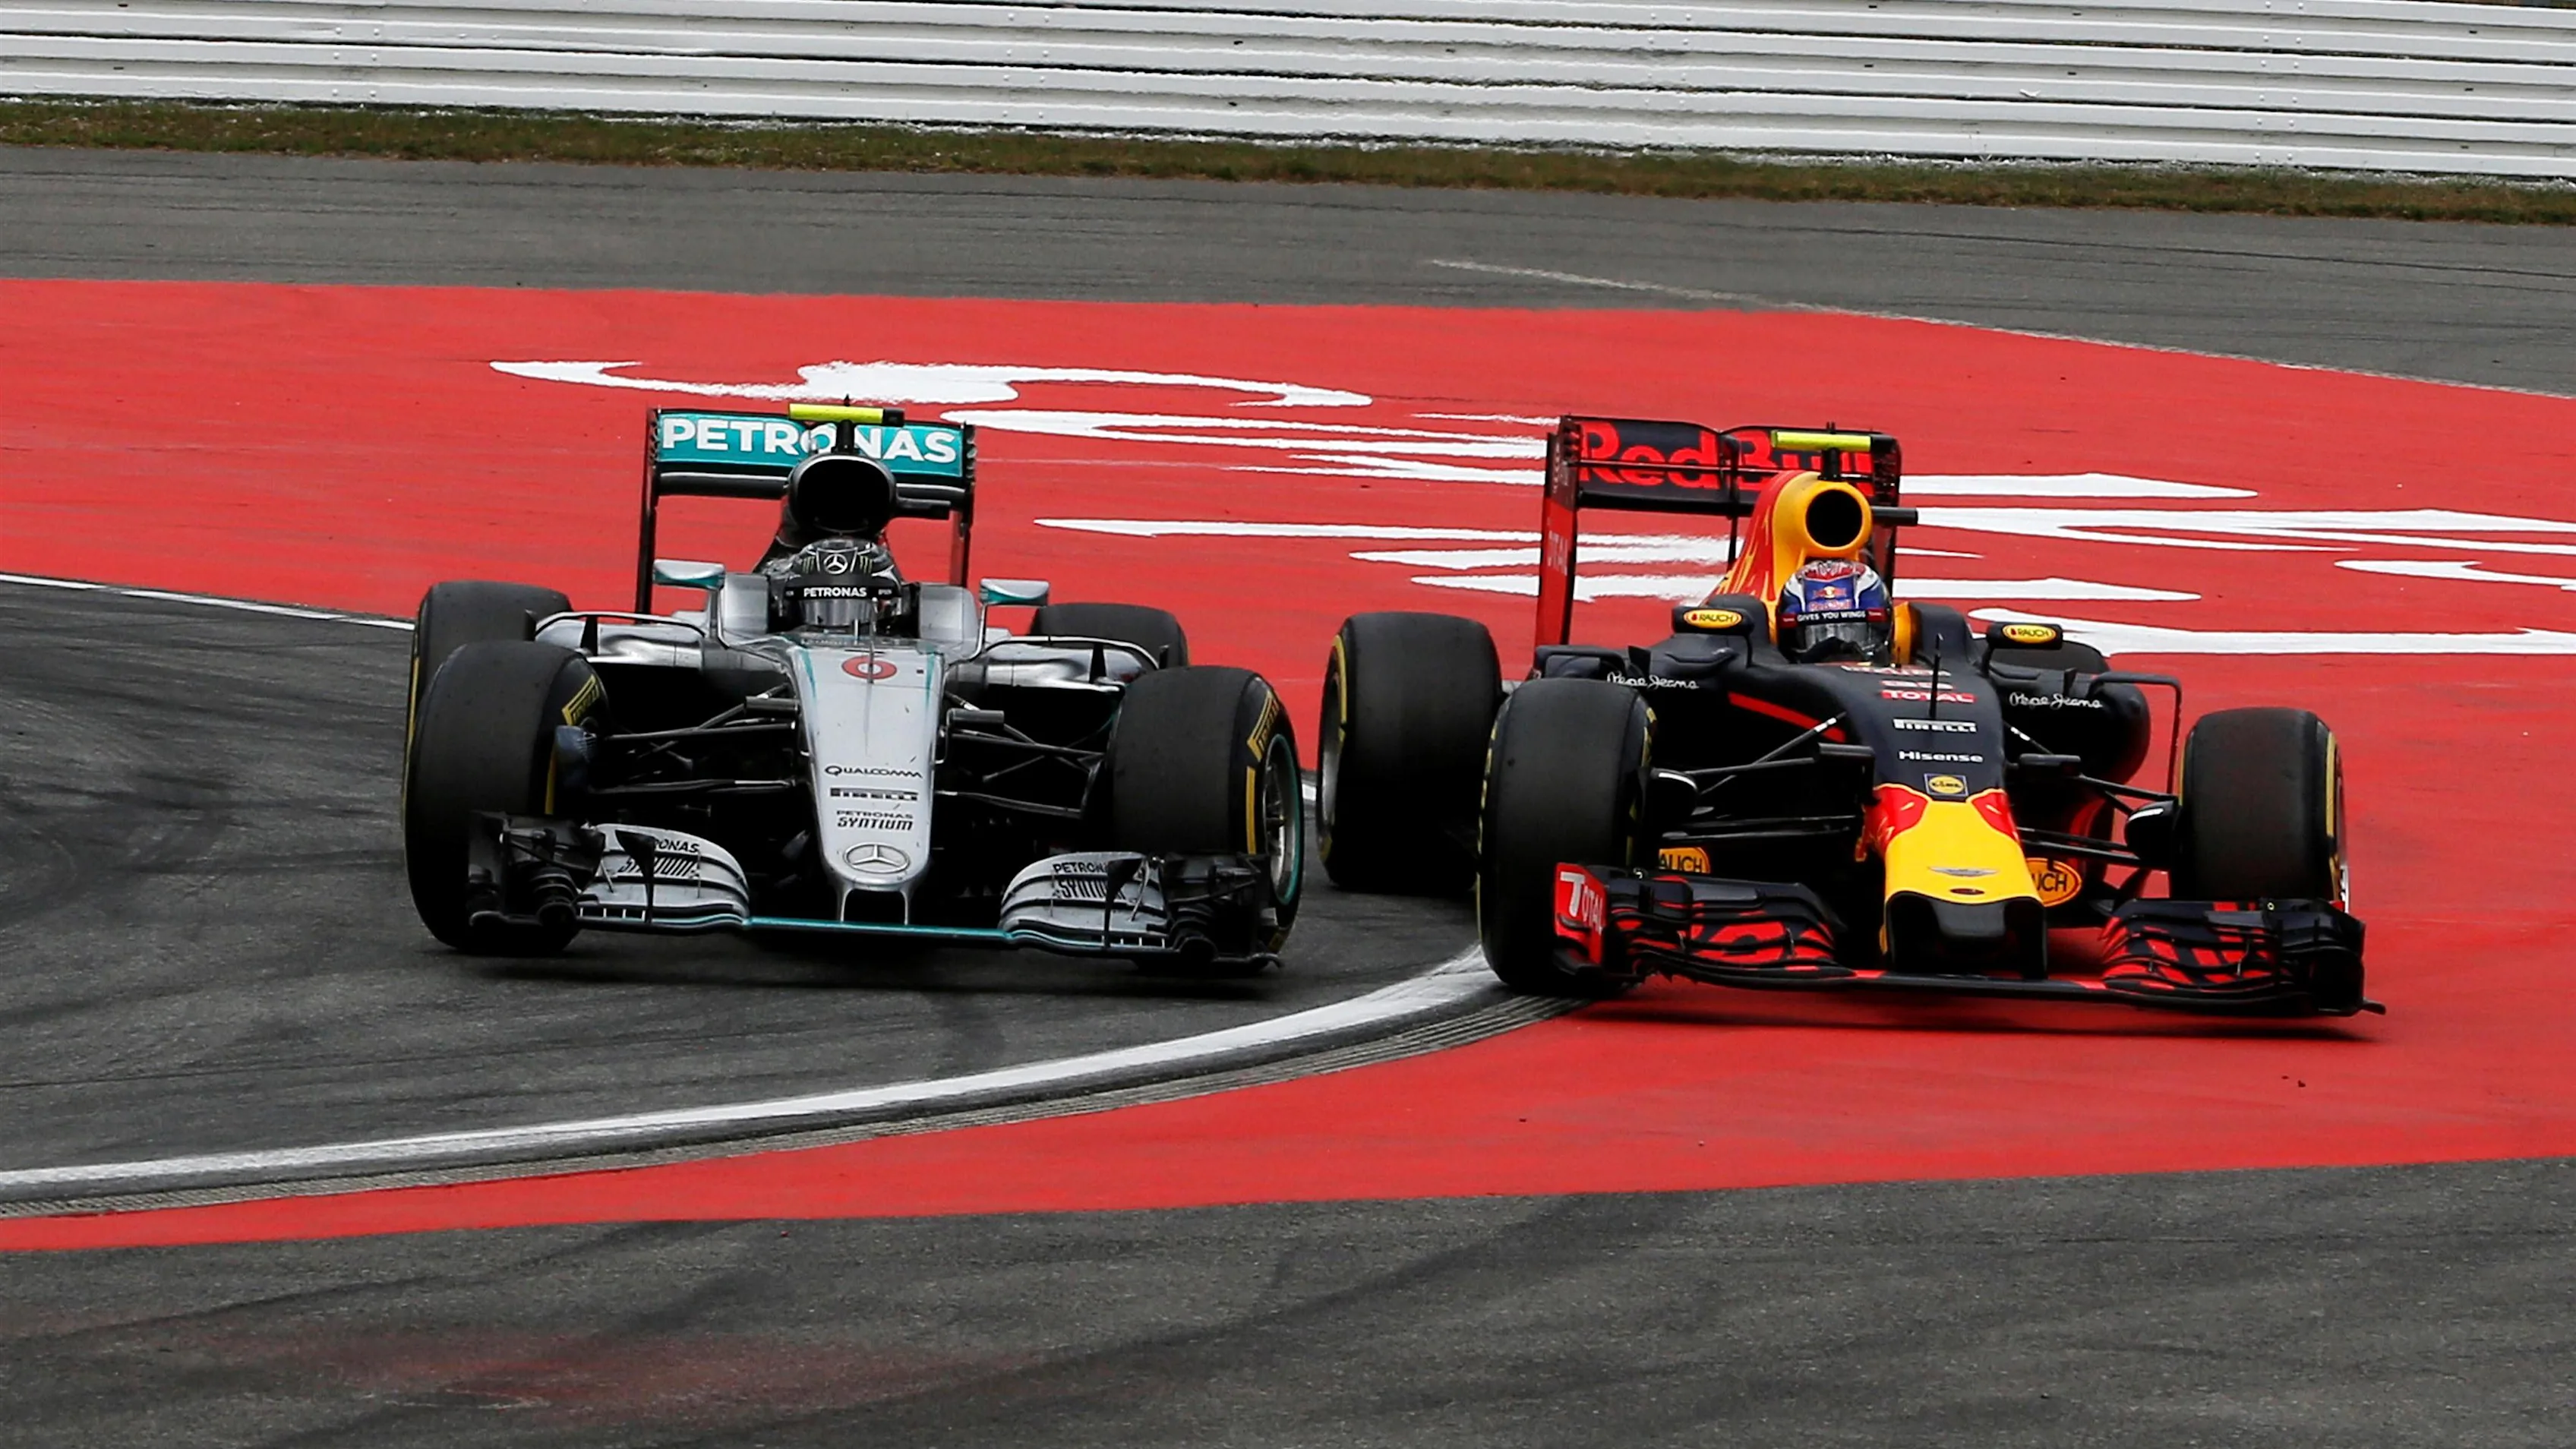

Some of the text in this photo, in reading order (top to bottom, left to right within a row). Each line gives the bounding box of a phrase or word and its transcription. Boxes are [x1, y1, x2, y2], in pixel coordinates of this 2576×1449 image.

[662, 418, 957, 464] PETRONAS
[1580, 421, 1720, 490] Red
[803, 587, 867, 597] PETRONAS
[1700, 614, 1733, 622] RAUCH
[1797, 614, 1820, 622] GIVES
[2017, 628, 2049, 636] RAUCH
[1886, 690, 1975, 702] TOTAL
[1893, 718, 1977, 732] PIRELLI
[1899, 750, 1984, 762] Hisense
[830, 788, 918, 800] PIRELLI
[836, 810, 913, 819] PETRONAS
[1659, 854, 1703, 872] AUCH
[2031, 873, 2068, 892] UCH
